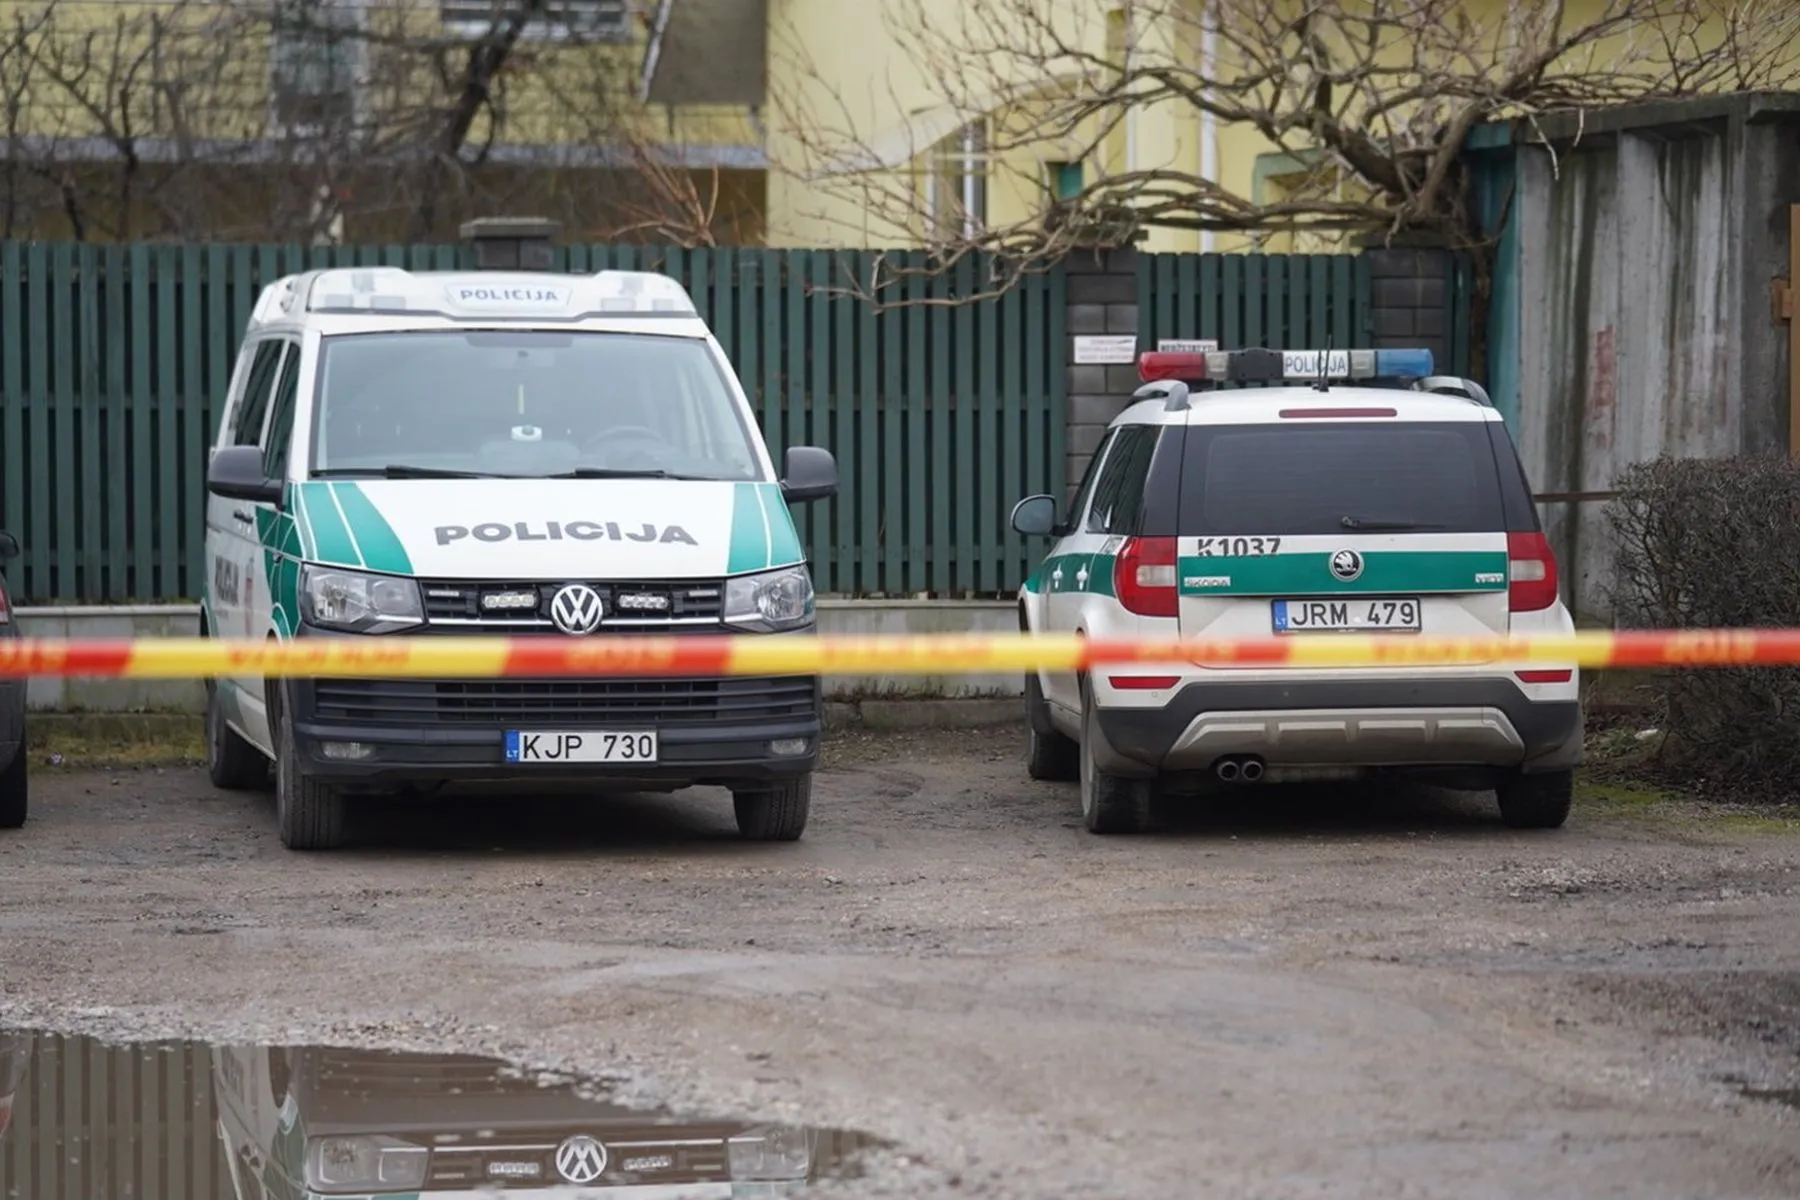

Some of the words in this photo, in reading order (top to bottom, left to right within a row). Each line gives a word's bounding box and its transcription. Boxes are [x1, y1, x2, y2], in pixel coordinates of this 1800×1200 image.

[460, 288, 559, 301] POLICIJA
[1284, 356, 1346, 373] POLICJA
[434, 521, 699, 546] POLICIJA
[1197, 537, 1281, 557] K1037
[1291, 603, 1349, 625] JRM
[1367, 602, 1415, 625] 479
[506, 750, 518, 759] LT
[523, 734, 583, 760] KJP
[603, 734, 653, 759] 730
